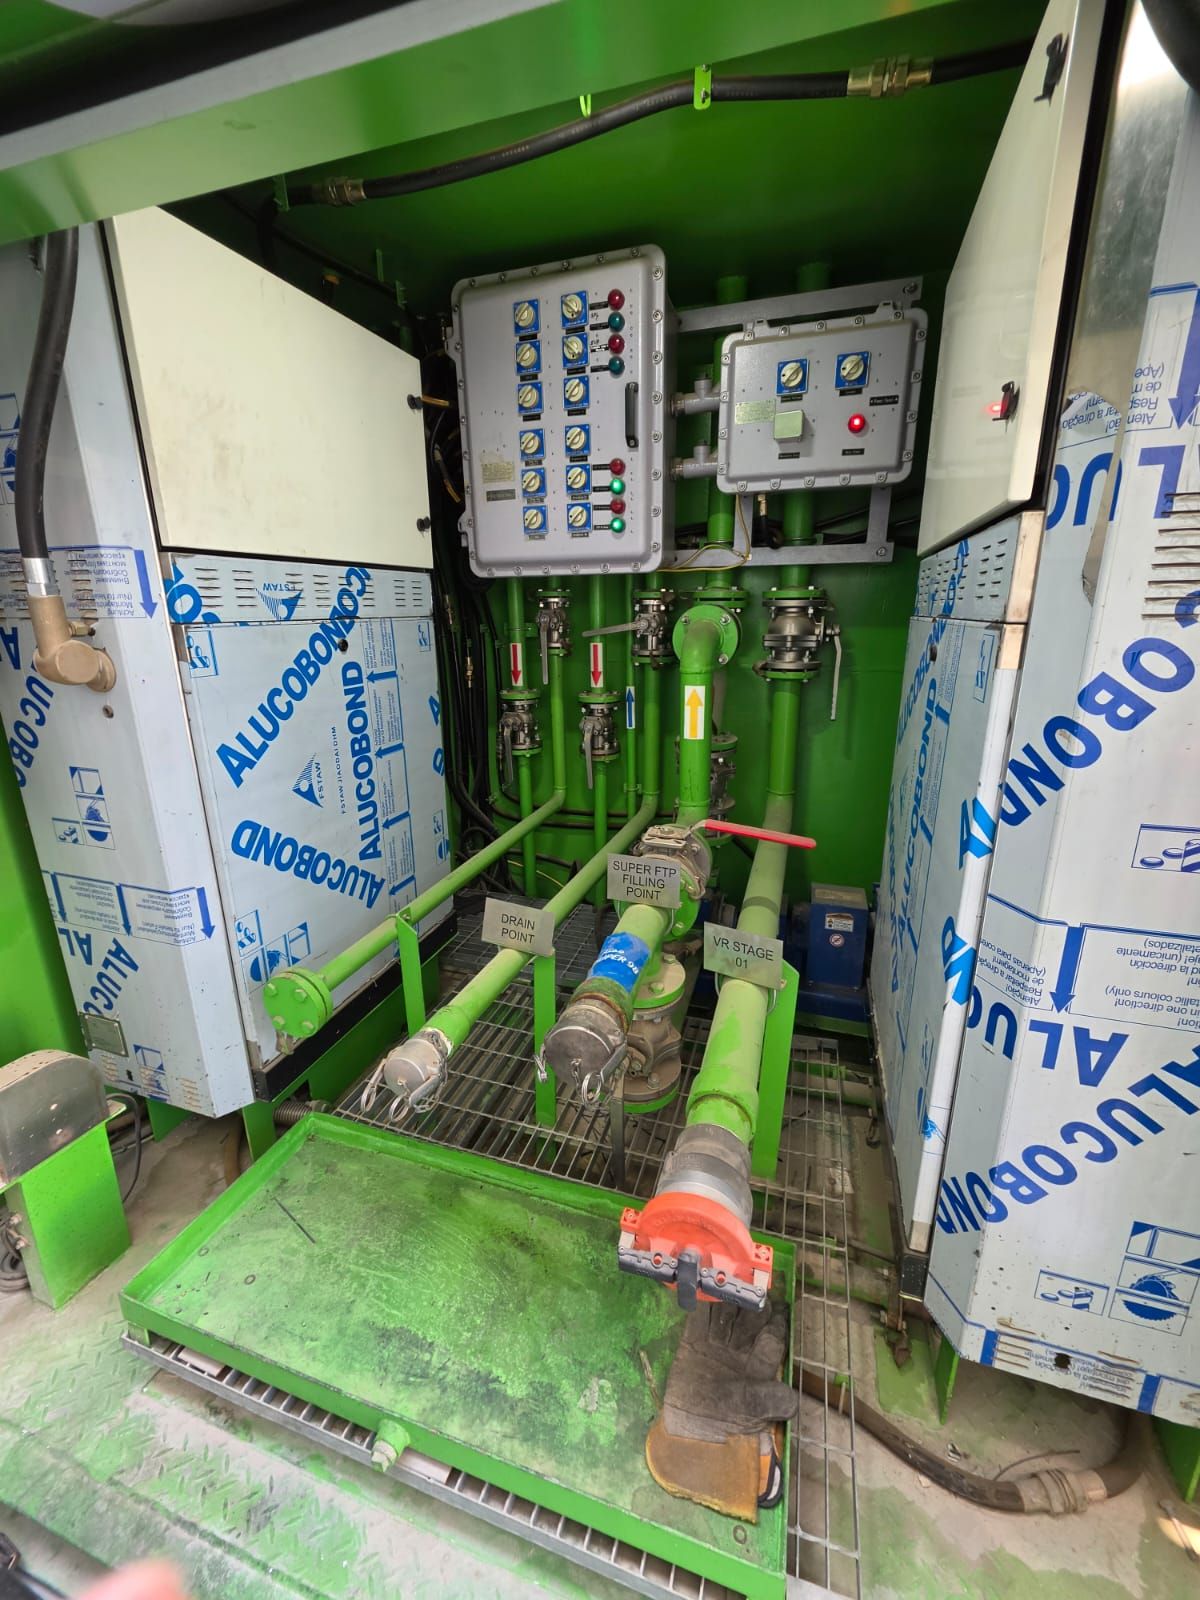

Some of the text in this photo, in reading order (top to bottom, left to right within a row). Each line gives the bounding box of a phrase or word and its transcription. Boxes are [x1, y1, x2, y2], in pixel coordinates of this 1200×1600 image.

[262, 582, 296, 592] FSTAW
[341, 660, 382, 862] ALUCOBOND
[230, 819, 386, 909] ALUCOBOND
[612, 860, 678, 877] SUPER FTP
[622, 873, 666, 890] FILLING
[626, 887, 662, 901] POINT
[500, 913, 536, 931] DRAIN
[500, 927, 536, 945] POINT
[713, 935, 775, 962] VR STAGE
[1116, 946, 1183, 964] (unicamente
[735, 957, 749, 969] 01
[1129, 959, 1178, 974] dirección
[1179, 965, 1189, 976] la
[1031, 977, 1045, 987] de
[1105, 985, 1132, 997] only)
[1133, 990, 1173, 1003] colours
[1114, 998, 1165, 1013] direction!
[1165, 1004, 1188, 1015] one
